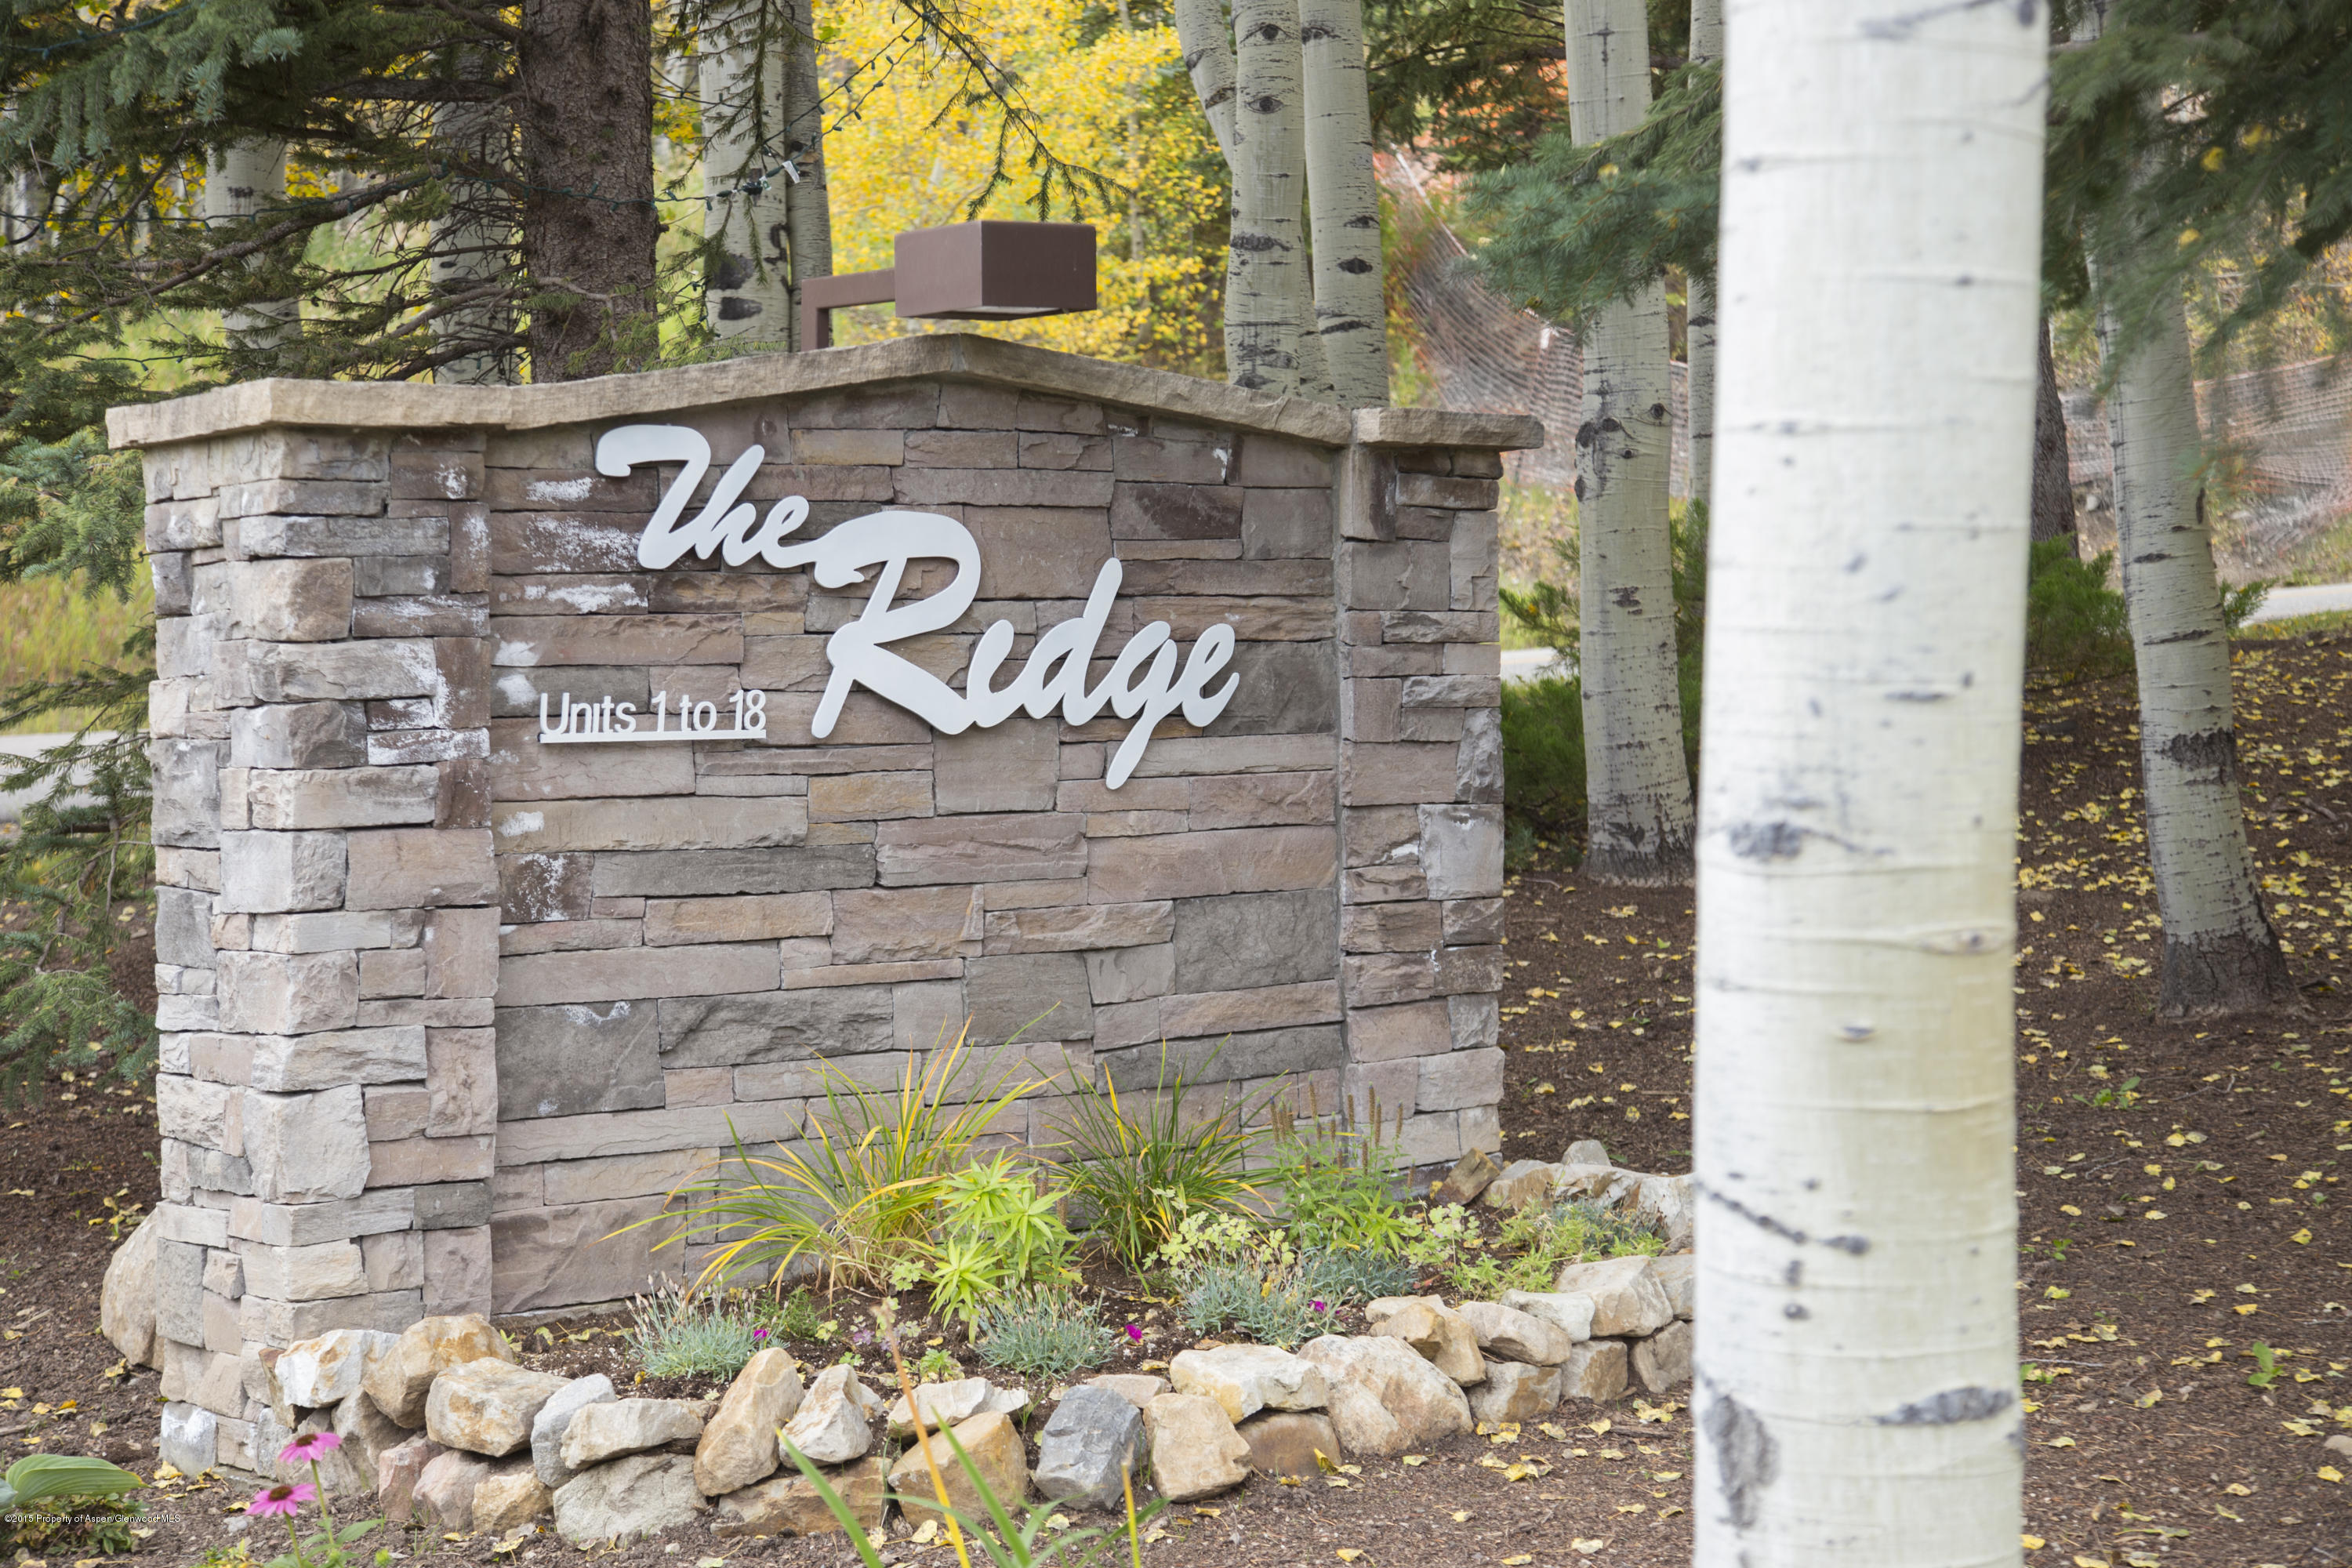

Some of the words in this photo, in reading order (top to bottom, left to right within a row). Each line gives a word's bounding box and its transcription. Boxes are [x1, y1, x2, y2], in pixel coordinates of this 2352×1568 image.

[595, 424, 813, 569] The
[539, 692, 637, 734] Units
[651, 690, 666, 732] 1
[679, 695, 717, 731] to
[729, 689, 767, 731] 18
[811, 510, 1240, 790] Ridge
